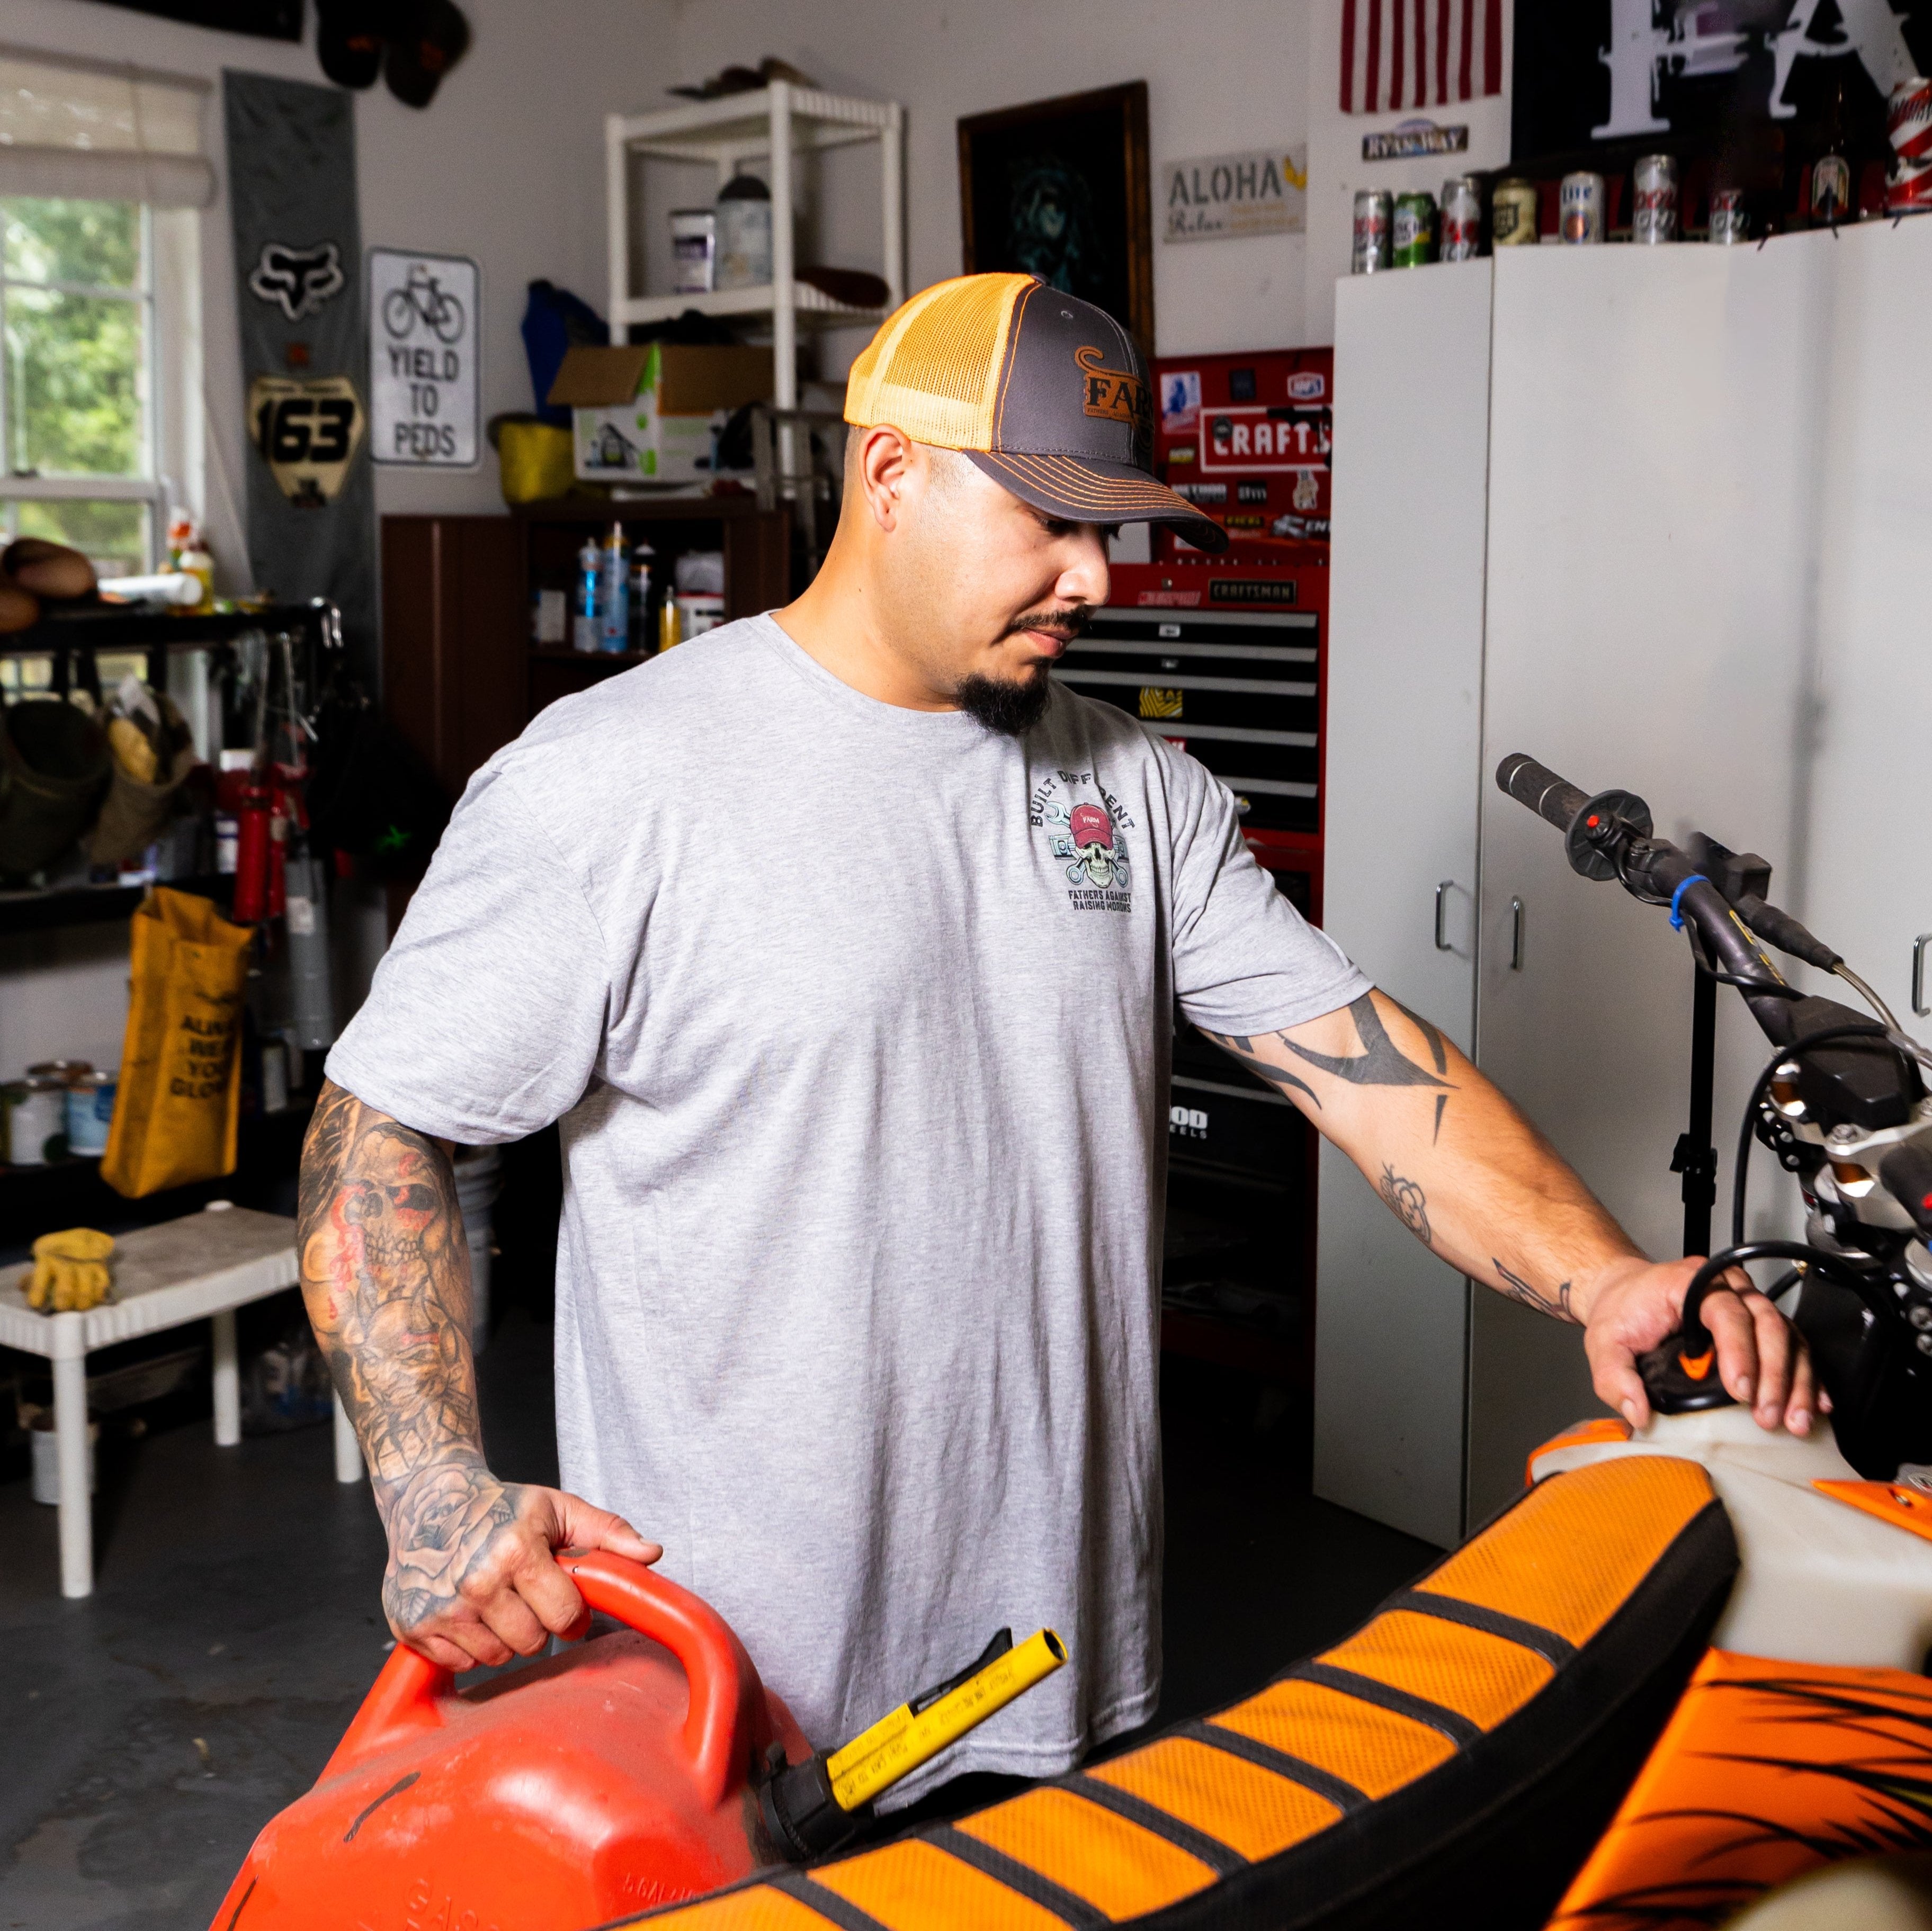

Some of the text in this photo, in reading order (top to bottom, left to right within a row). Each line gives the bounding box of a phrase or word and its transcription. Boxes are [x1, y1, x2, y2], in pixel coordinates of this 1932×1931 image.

[1169, 159, 1282, 208] ALOHA
[387, 347, 459, 382] YIELD
[409, 383, 440, 418] TO
[258, 399, 355, 463] 163
[394, 423, 457, 457] PEDS
[1213, 585, 1290, 599] CRAFTSMAN
[1031, 778, 1057, 827] BUILT
[1068, 890, 1131, 903] FATHERS AGAINST
[1073, 901, 1131, 913] RAISING MORONS
[1169, 1106, 1208, 1130] OD
[404, 1879, 500, 1931] GAS
